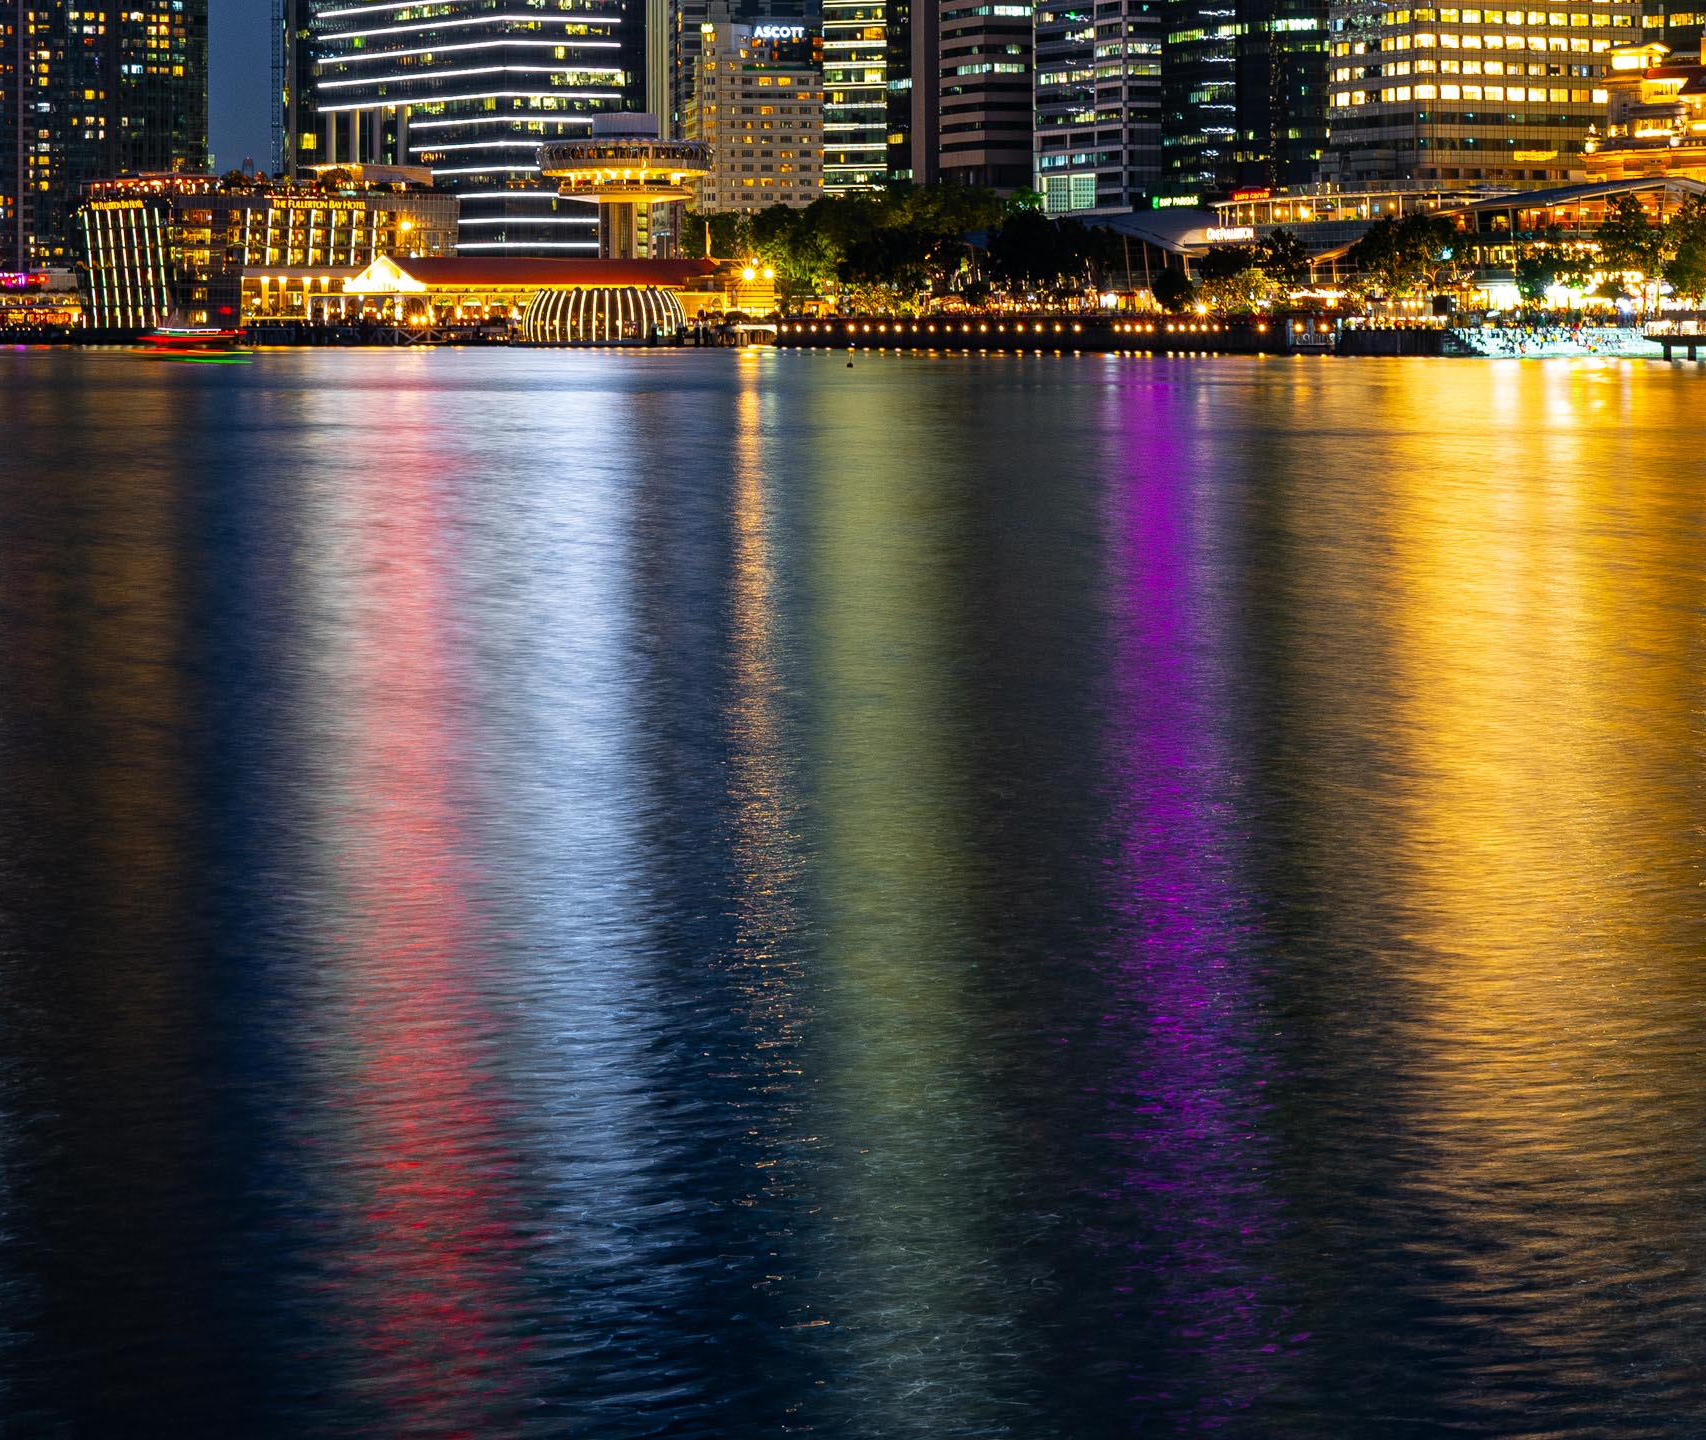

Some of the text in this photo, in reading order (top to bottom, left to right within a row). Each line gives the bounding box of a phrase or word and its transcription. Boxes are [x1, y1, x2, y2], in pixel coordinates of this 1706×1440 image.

[754, 25, 805, 39] ASCOTT
[273, 199, 366, 209] THE FULLERTON BAY HOTEL
